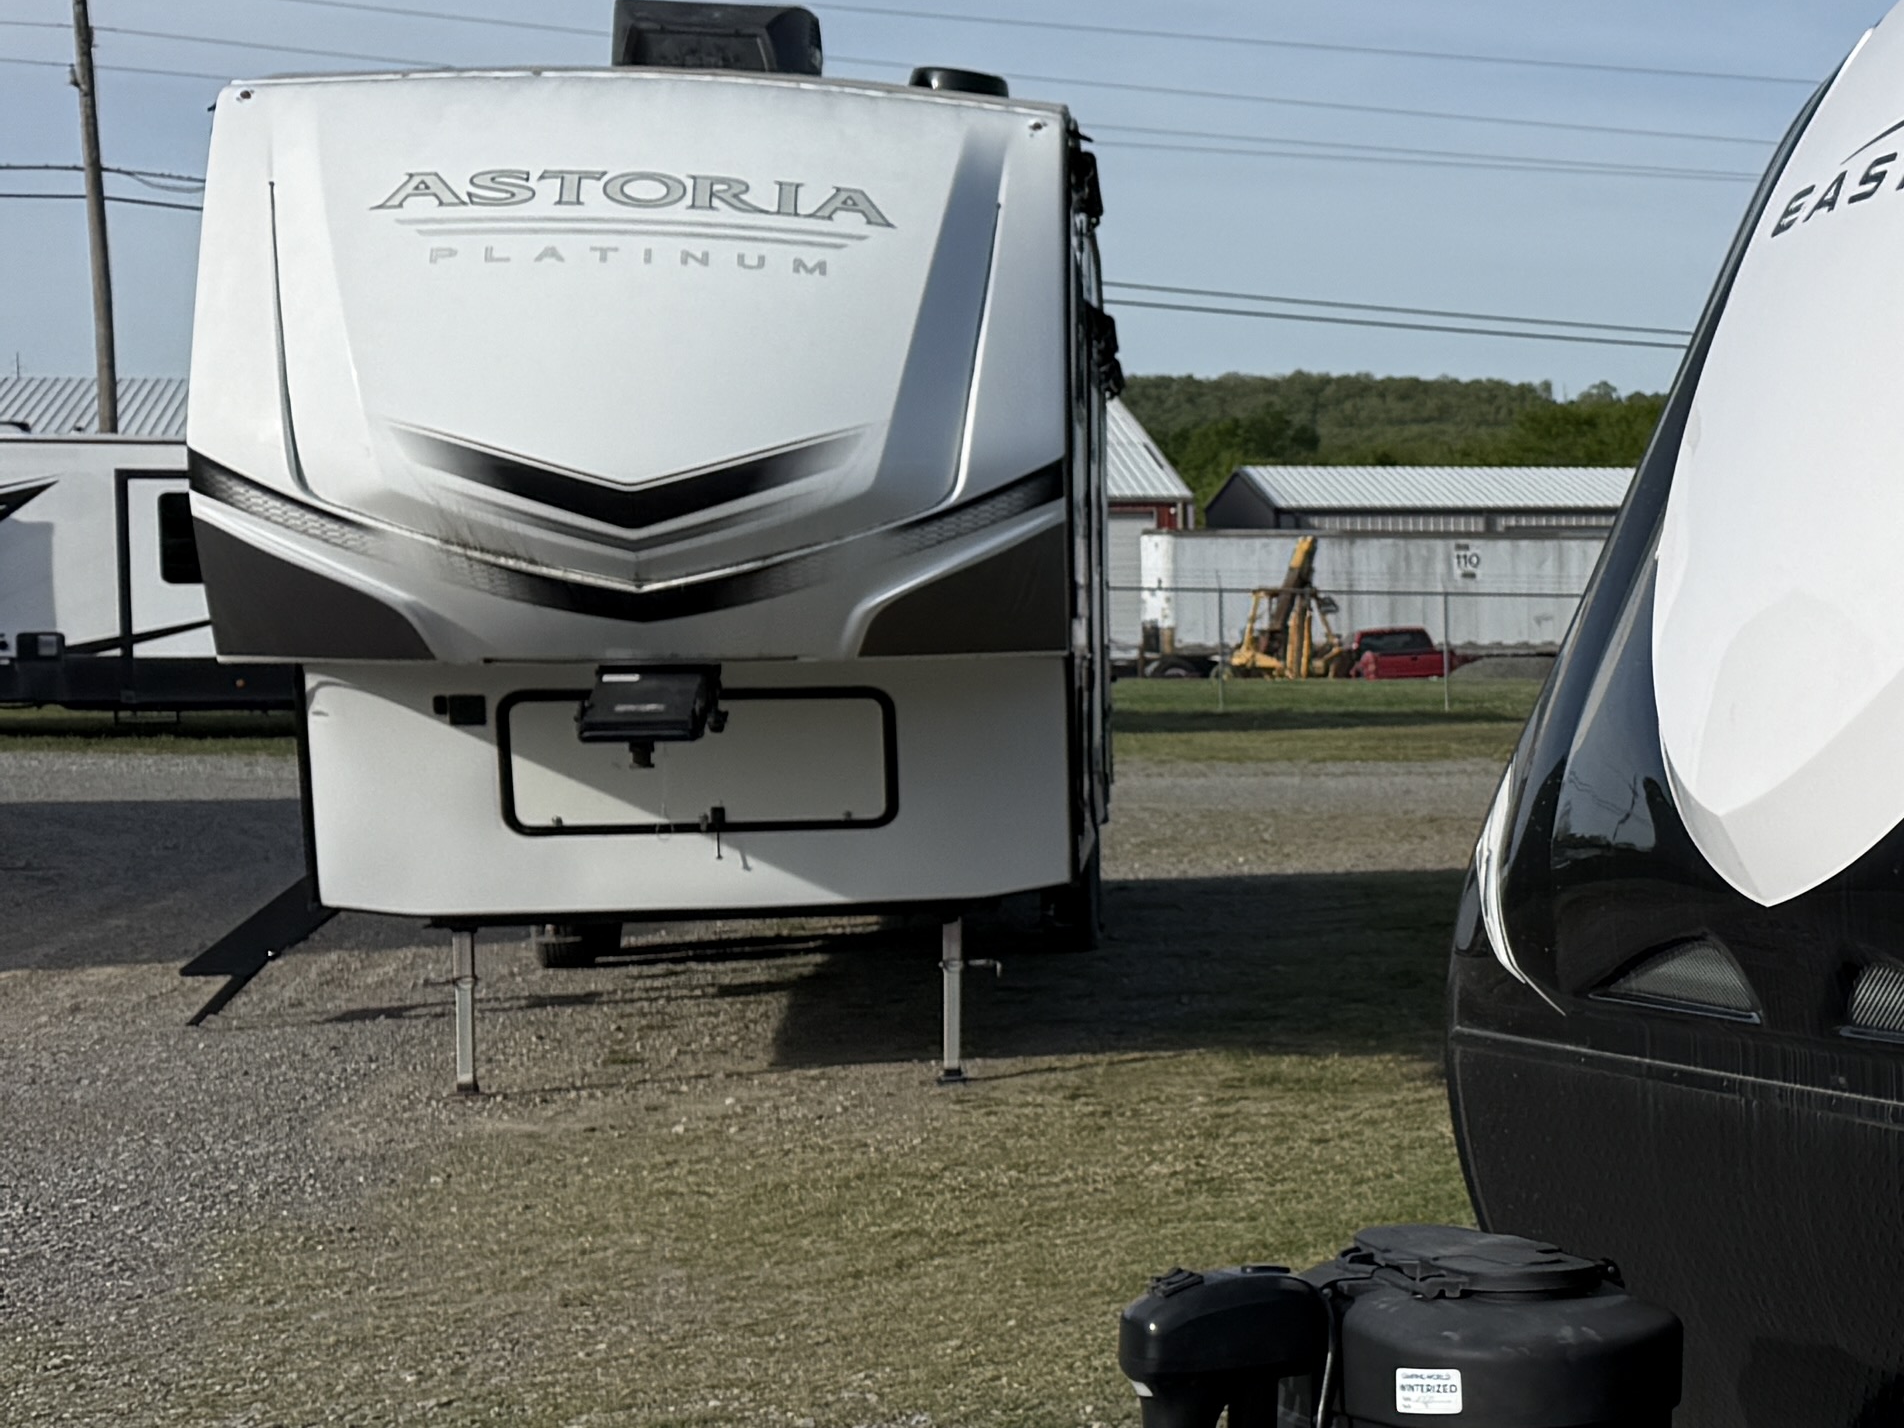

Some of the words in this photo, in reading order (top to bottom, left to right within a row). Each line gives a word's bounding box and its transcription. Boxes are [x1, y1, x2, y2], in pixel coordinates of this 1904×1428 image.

[369, 169, 897, 229] ASTORIA
[429, 245, 828, 277] PLATINUM
[1456, 552, 1480, 569] 110
[1400, 1383, 1458, 1394] WINTERIZED
